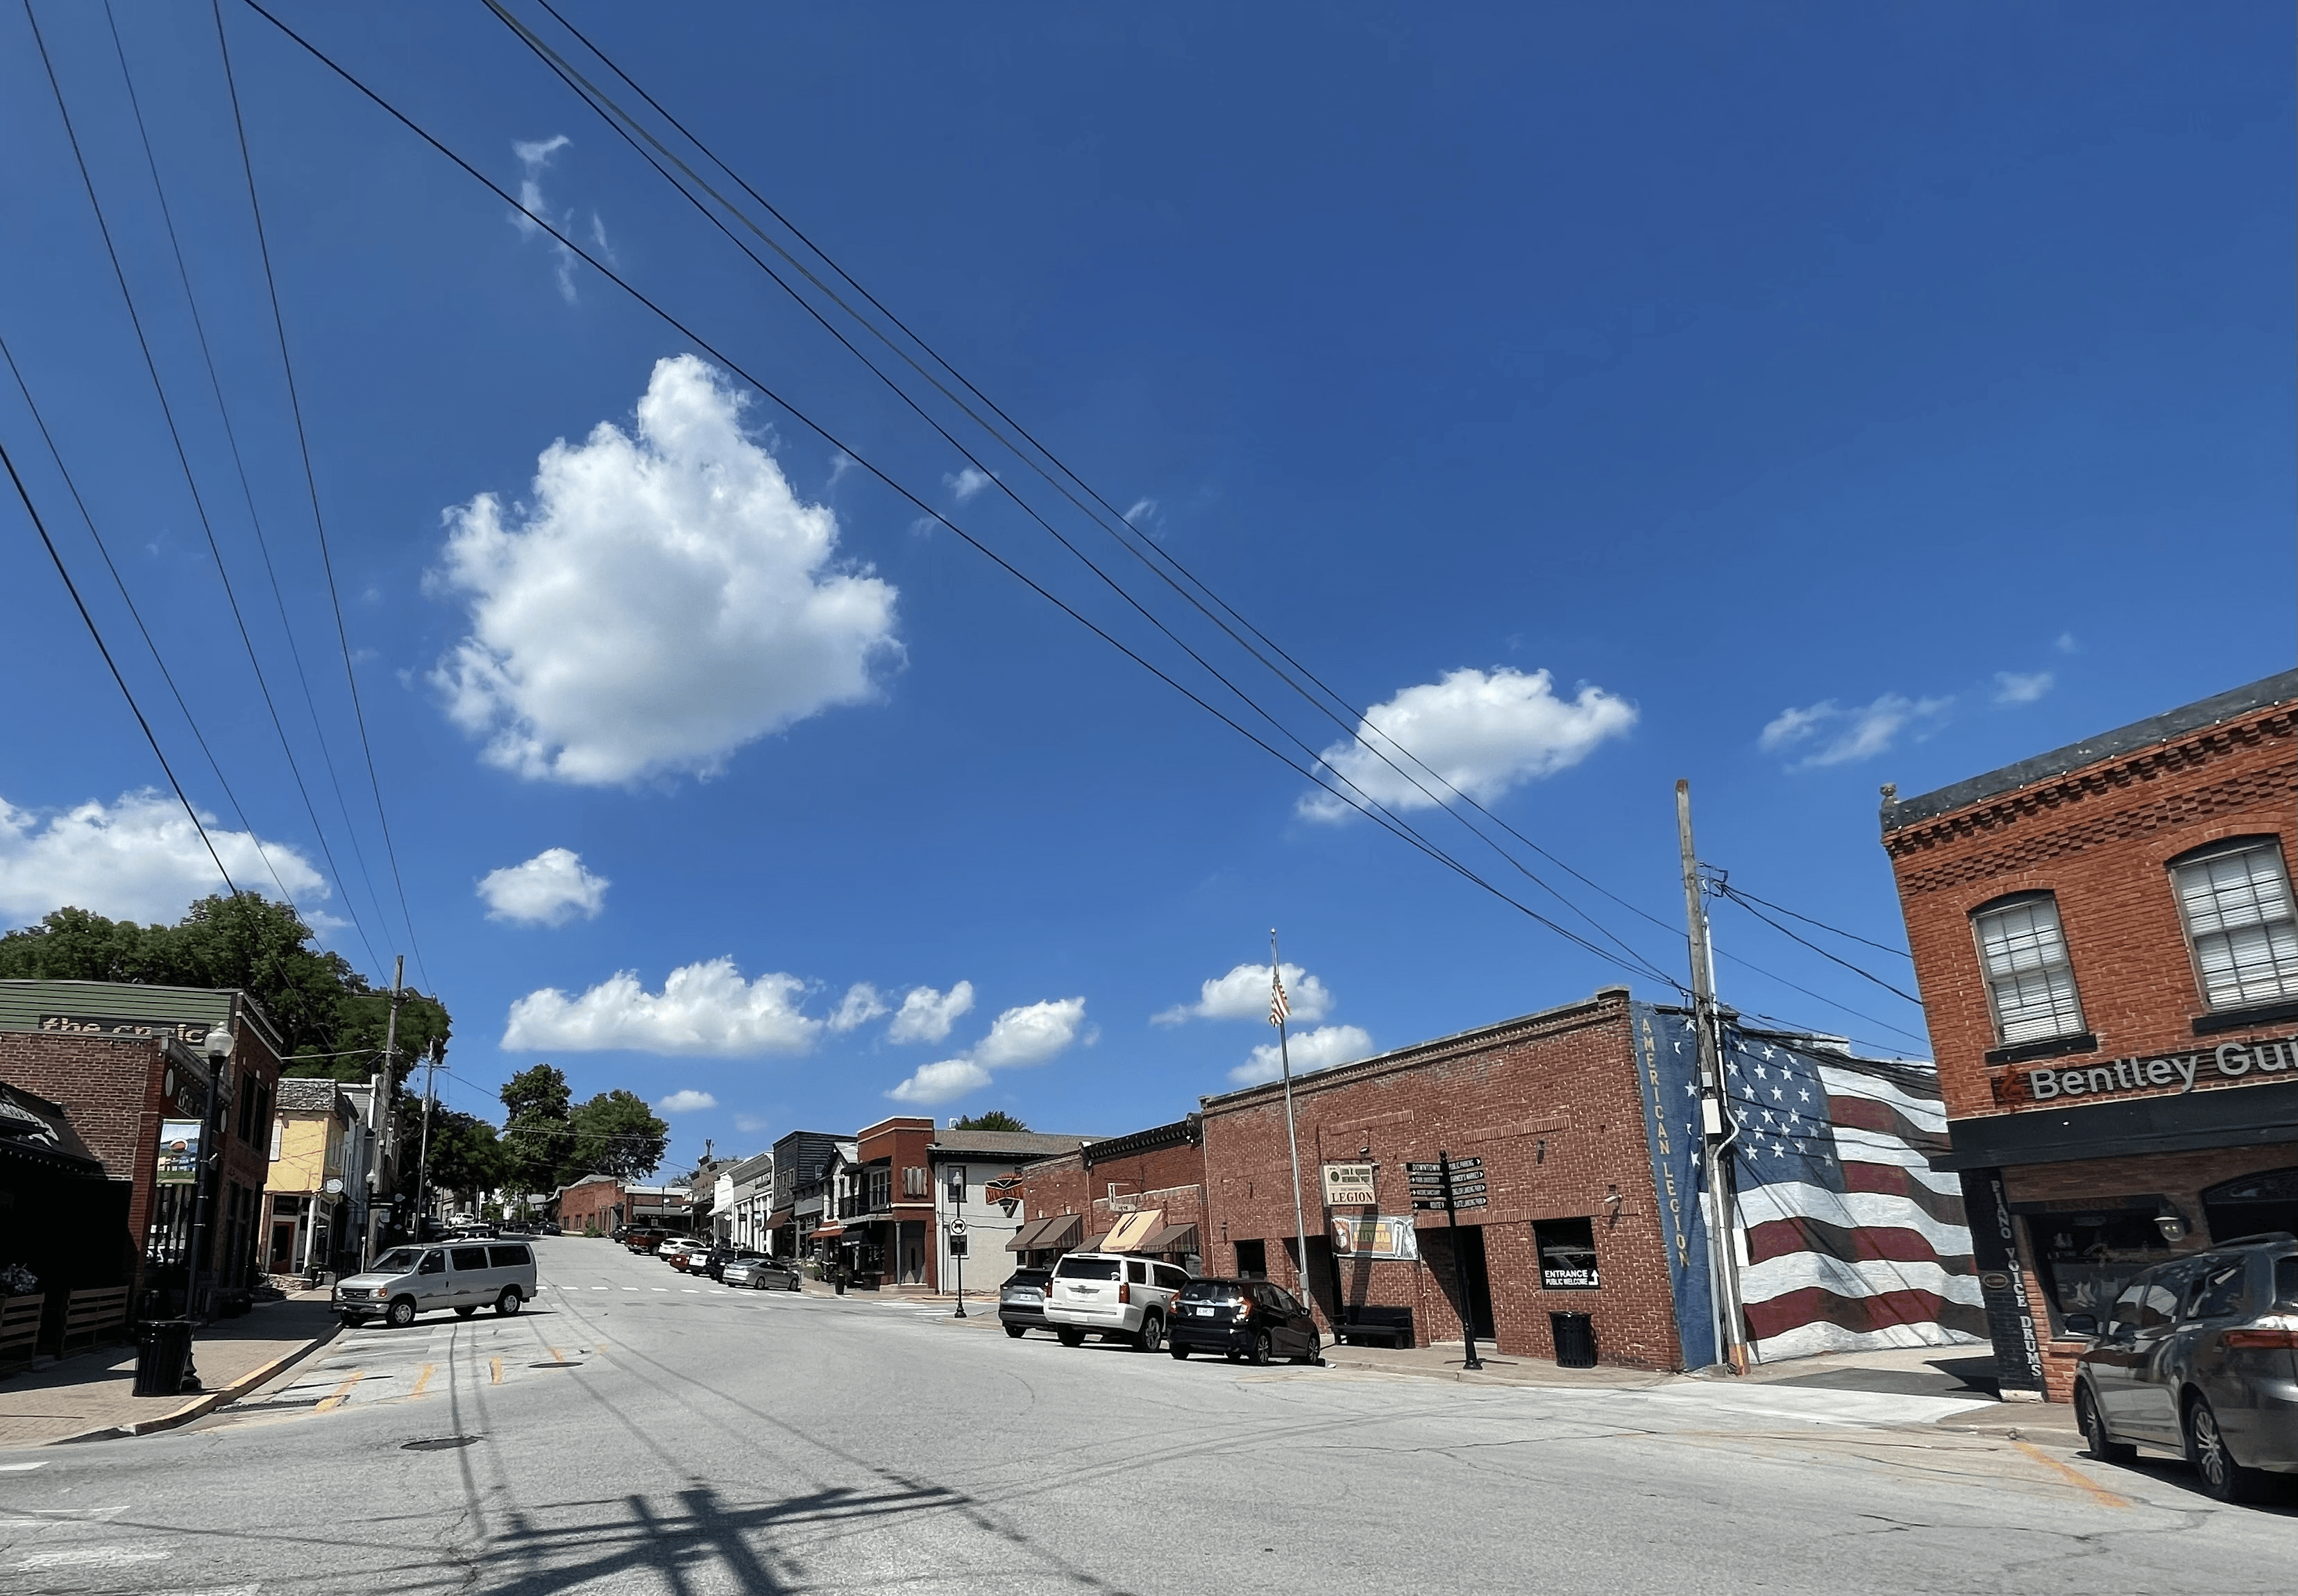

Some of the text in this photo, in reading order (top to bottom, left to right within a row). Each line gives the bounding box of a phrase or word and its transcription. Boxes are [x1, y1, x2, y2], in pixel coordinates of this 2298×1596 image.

[2029, 1055, 2197, 1099] Bentley
[1641, 1018, 1690, 1267] AMERICAN LEGION
[1331, 1192, 1373, 1203] LEGION
[1544, 1269, 1588, 1277] ENTRANCE
[1990, 1180, 2042, 1377] PIANO VOICE DRUMS
